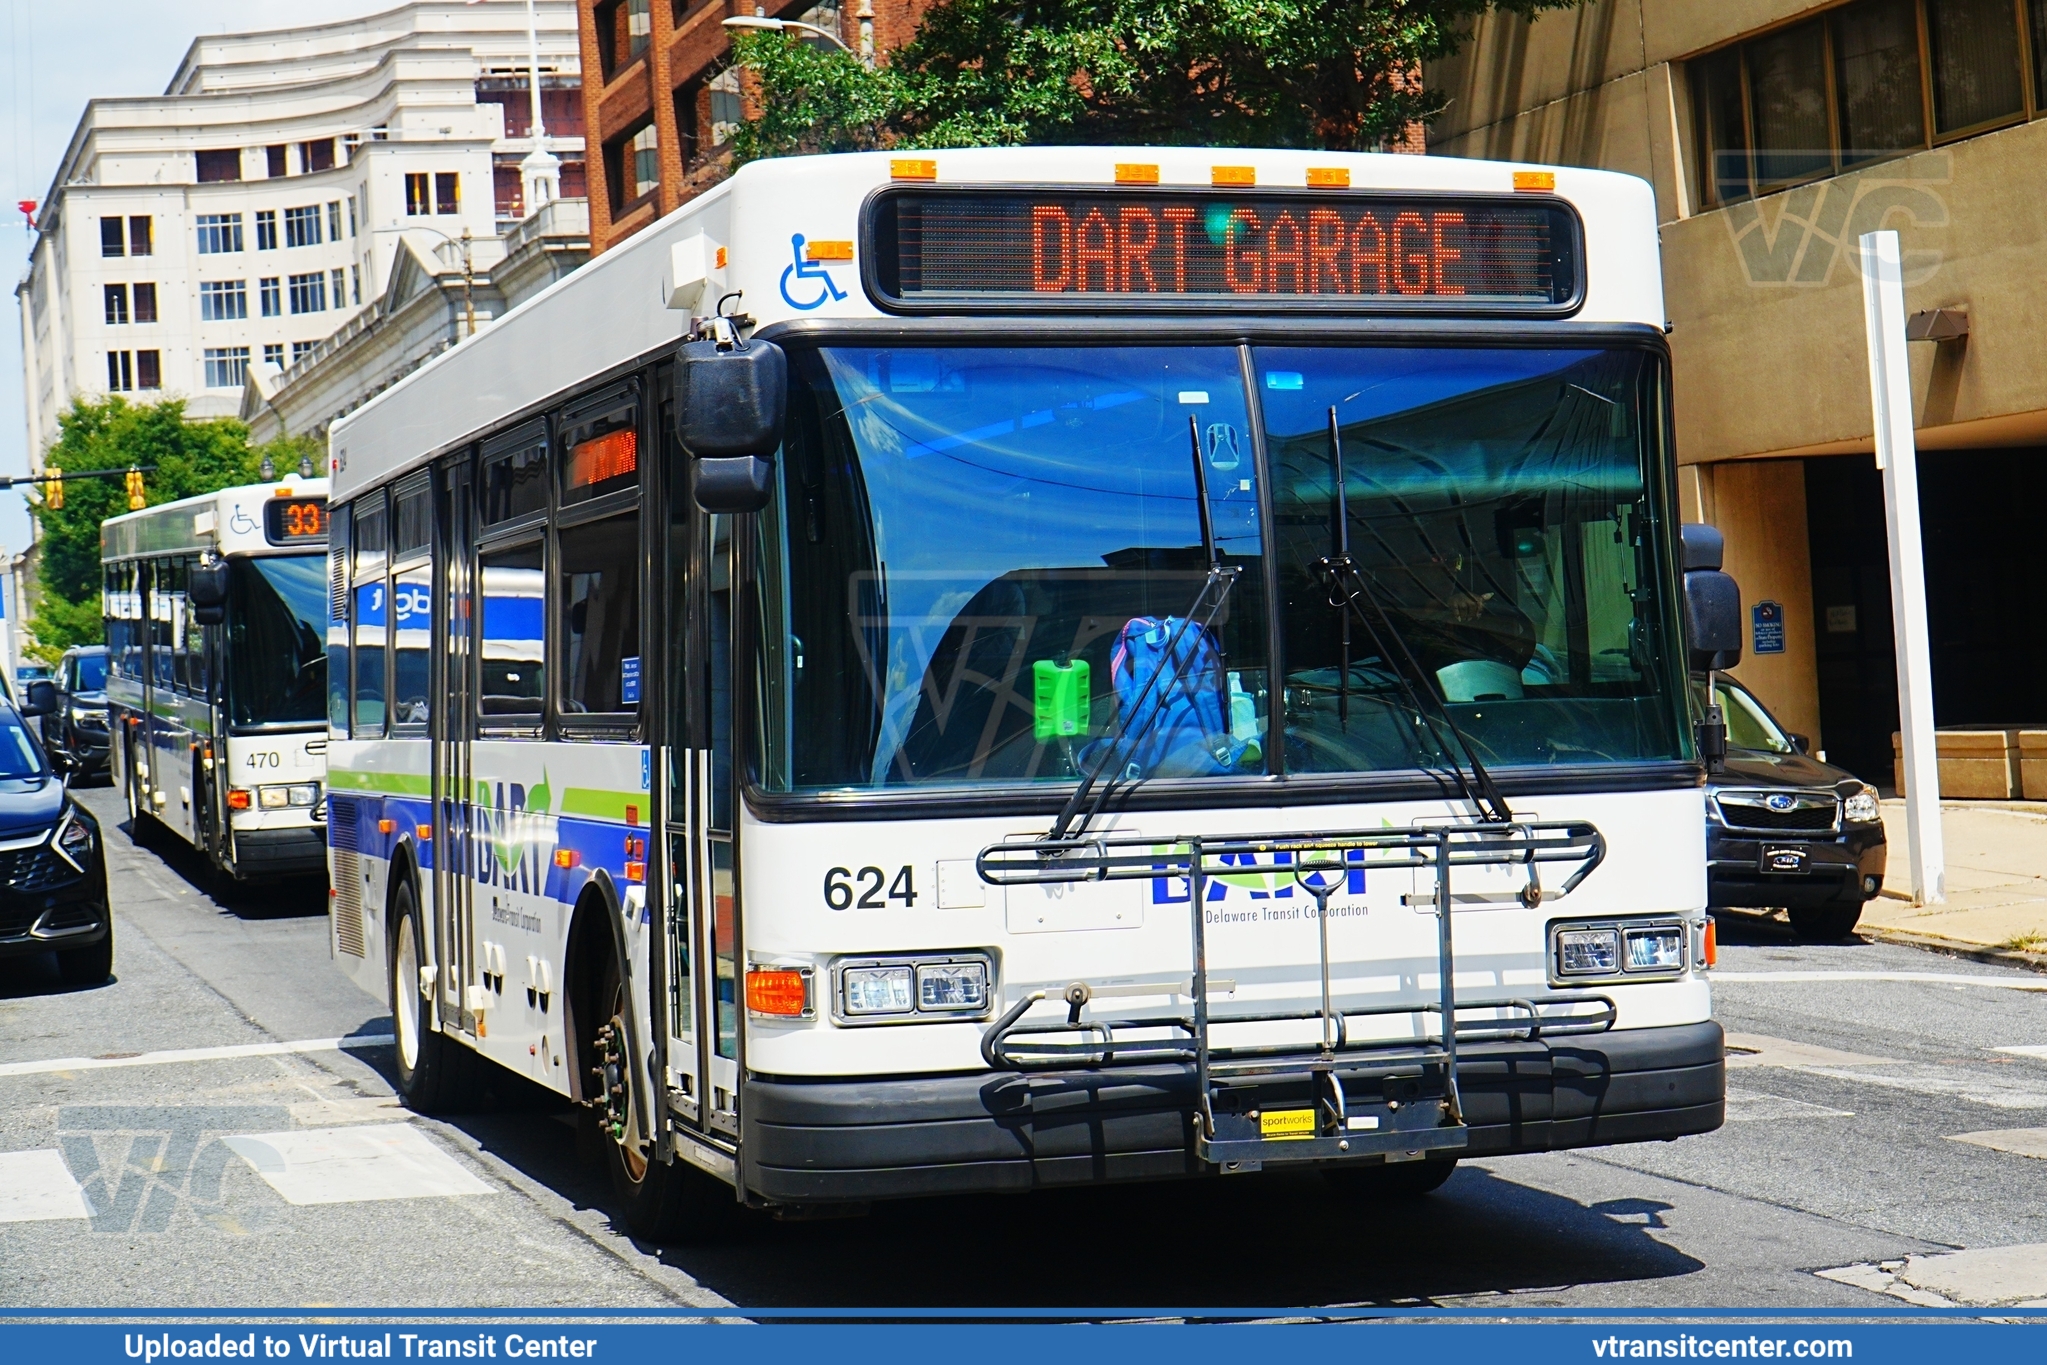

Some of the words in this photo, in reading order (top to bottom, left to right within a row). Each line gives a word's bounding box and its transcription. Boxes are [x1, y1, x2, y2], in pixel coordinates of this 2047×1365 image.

[1032, 205, 1196, 293] DART
[1225, 208, 1466, 296] GARAGE
[287, 503, 321, 536] 33
[246, 752, 280, 769] 470
[823, 865, 918, 911] 624
[1205, 909, 1258, 924] Delaware
[1262, 907, 1300, 921] Transit
[1304, 903, 1369, 919] Coporation
[1262, 1115, 1313, 1127] sportworks
